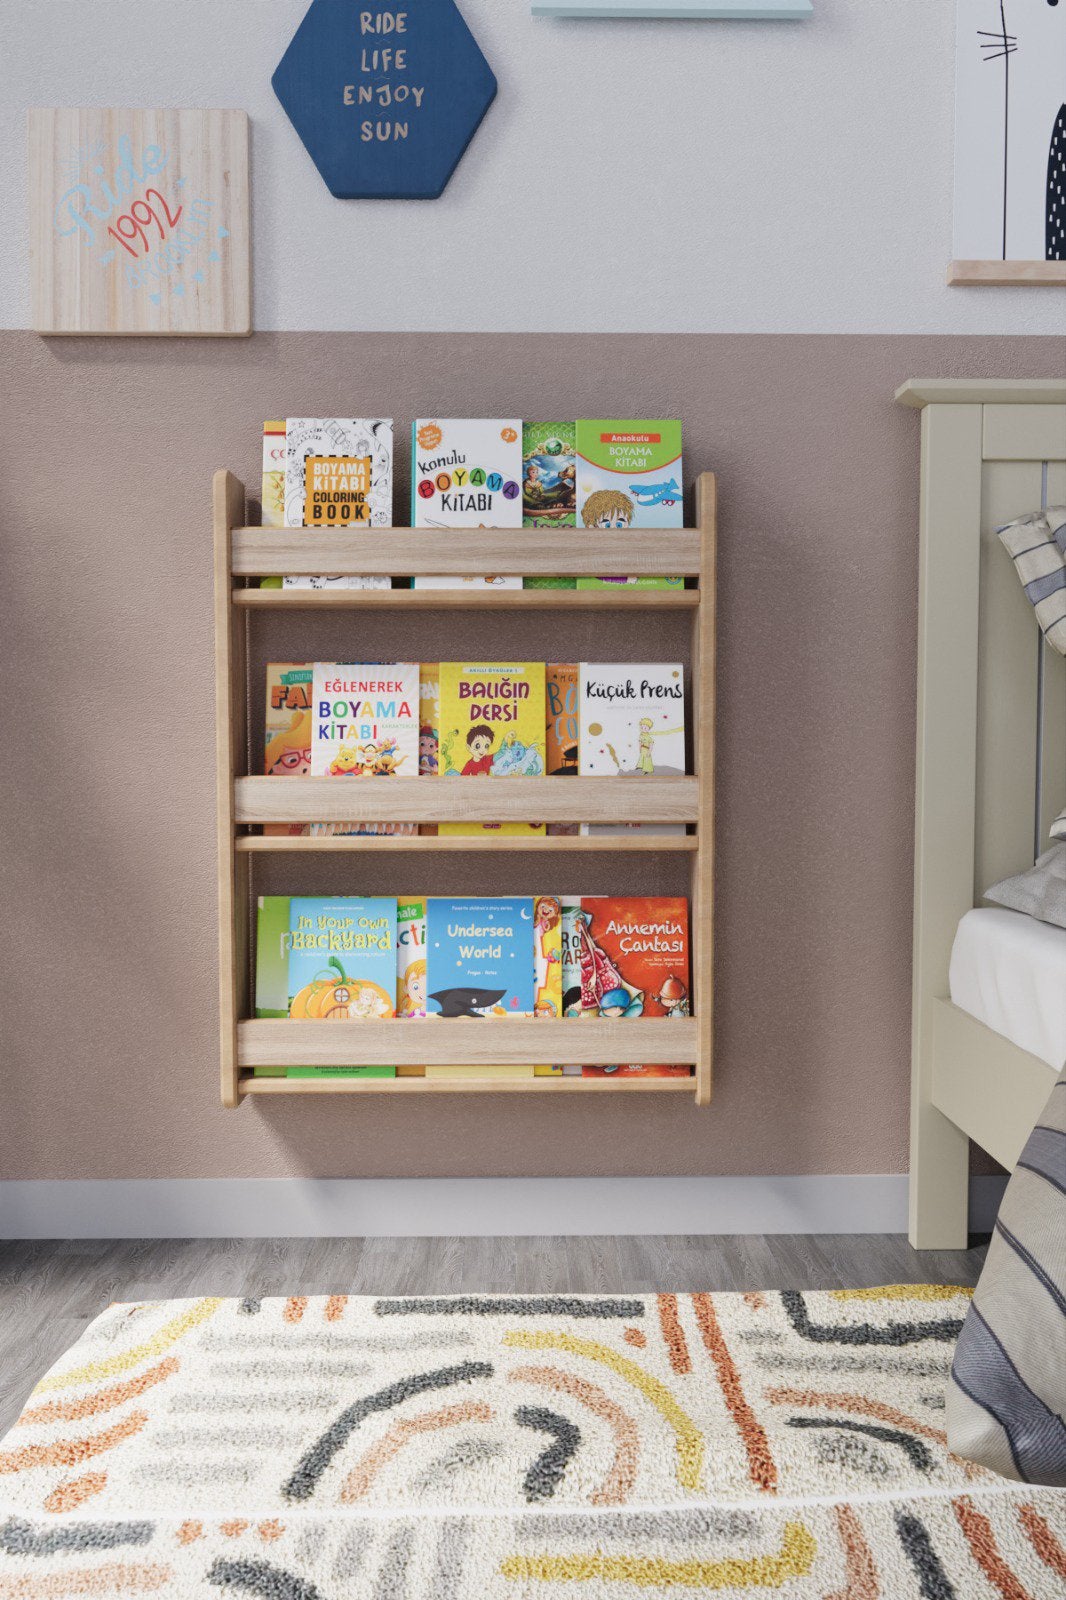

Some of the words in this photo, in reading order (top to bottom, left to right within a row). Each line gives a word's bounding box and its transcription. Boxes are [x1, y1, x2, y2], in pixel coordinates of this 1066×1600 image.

[360, 11, 408, 35] RIDE
[361, 48, 407, 72] LIFE
[343, 84, 425, 107] ENJOY
[361, 120, 408, 142] SUN
[54, 134, 171, 247] Ride
[107, 188, 183, 258] 1992
[611, 434, 650, 442] Anaokulu
[609, 446, 653, 456] BOYAMA
[313, 462, 366, 475] BOYAMA
[614, 456, 647, 468] KİTABI
[419, 468, 518, 498] BOYAMA
[313, 492, 365, 503] COLORING
[313, 505, 364, 519] BOOK
[324, 678, 404, 693] EĞLENEREK
[586, 680, 637, 701] Küçük
[640, 680, 683, 699] Prens
[319, 701, 412, 718] BOYAMA
[319, 721, 378, 740] KİTABI
[298, 915, 313, 930] In
[447, 923, 514, 937] Undersea
[605, 920, 684, 936] Annemin
[291, 930, 392, 950] Backyard
[619, 937, 684, 957] Çantası
[459, 945, 502, 959] World
